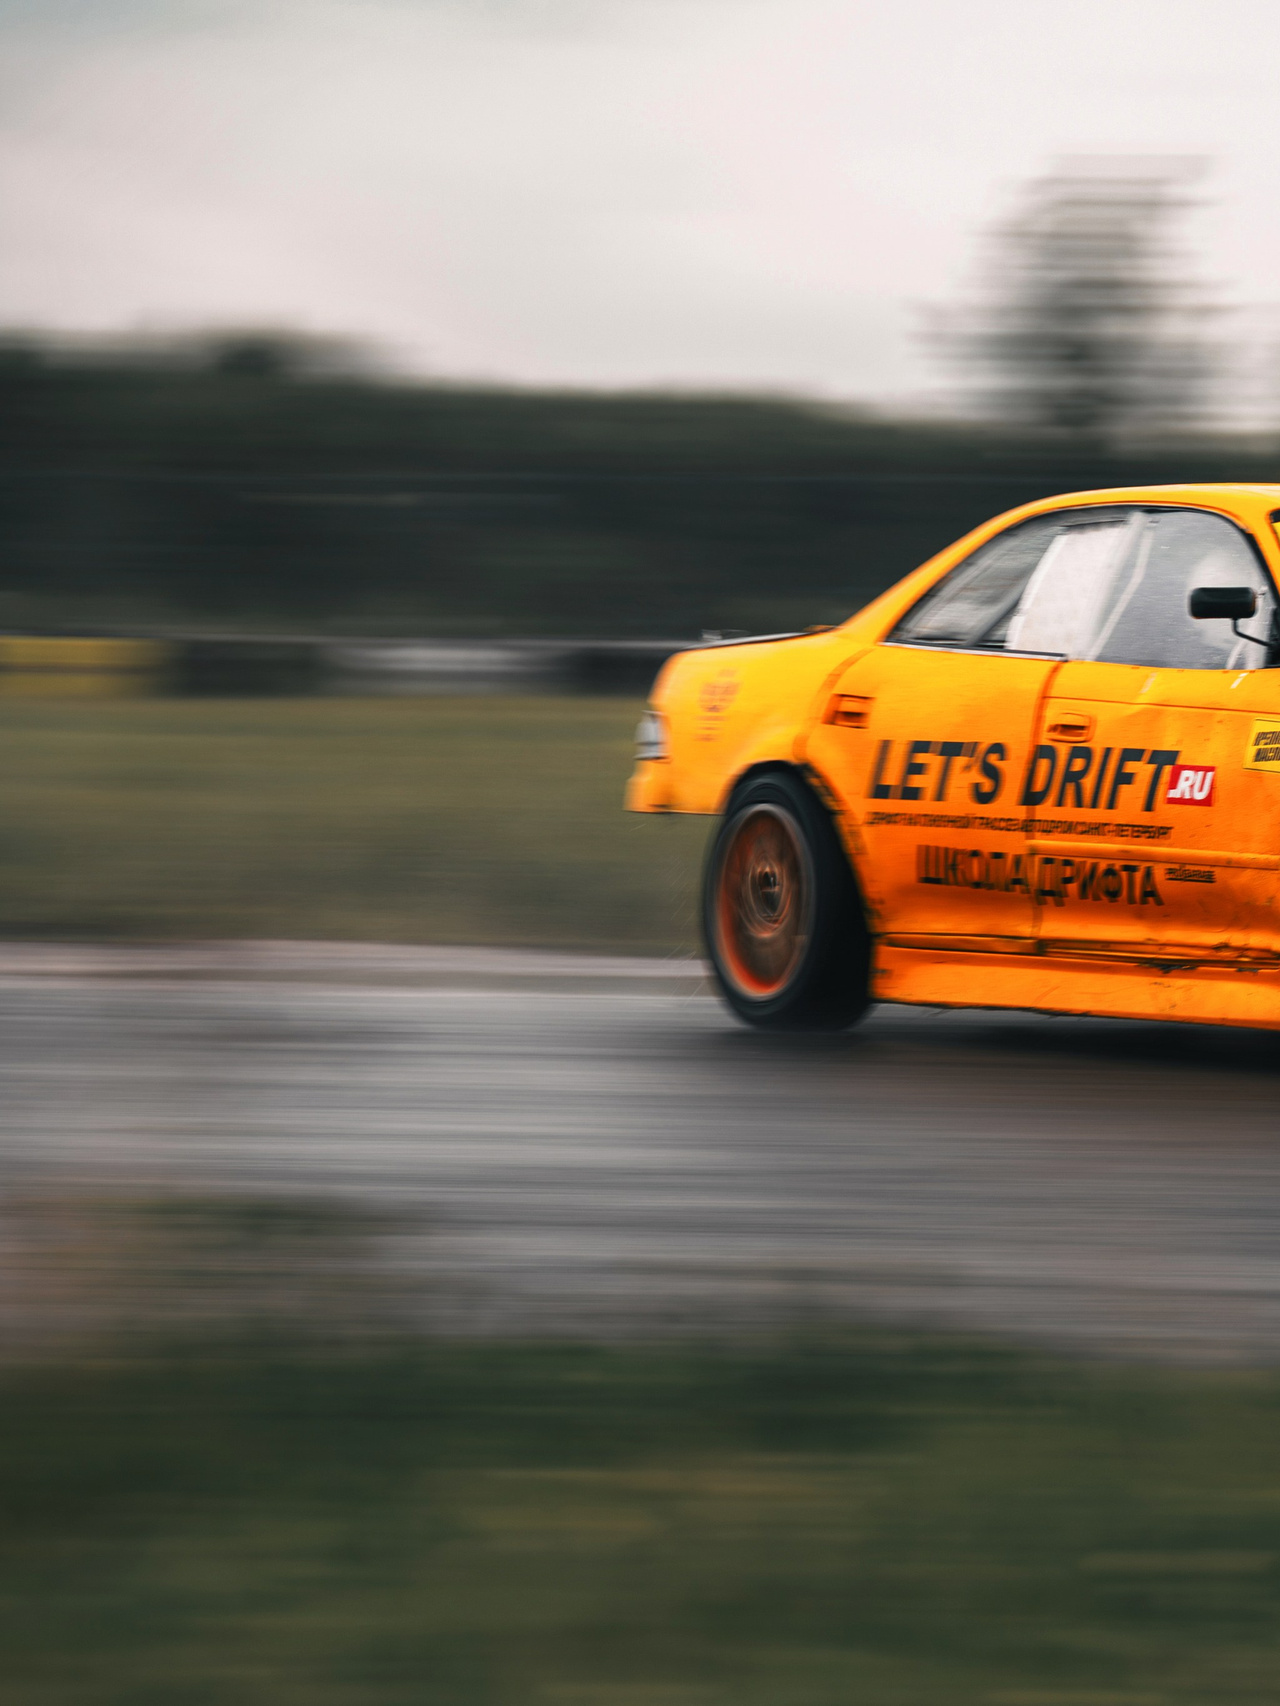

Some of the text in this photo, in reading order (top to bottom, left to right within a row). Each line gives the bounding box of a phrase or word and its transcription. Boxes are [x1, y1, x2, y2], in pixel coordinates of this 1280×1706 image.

[868, 739, 1008, 805] LET'S
[1016, 744, 1181, 812] DRIFT
[916, 844, 1166, 907] ШКОЛА ДРИФТА
